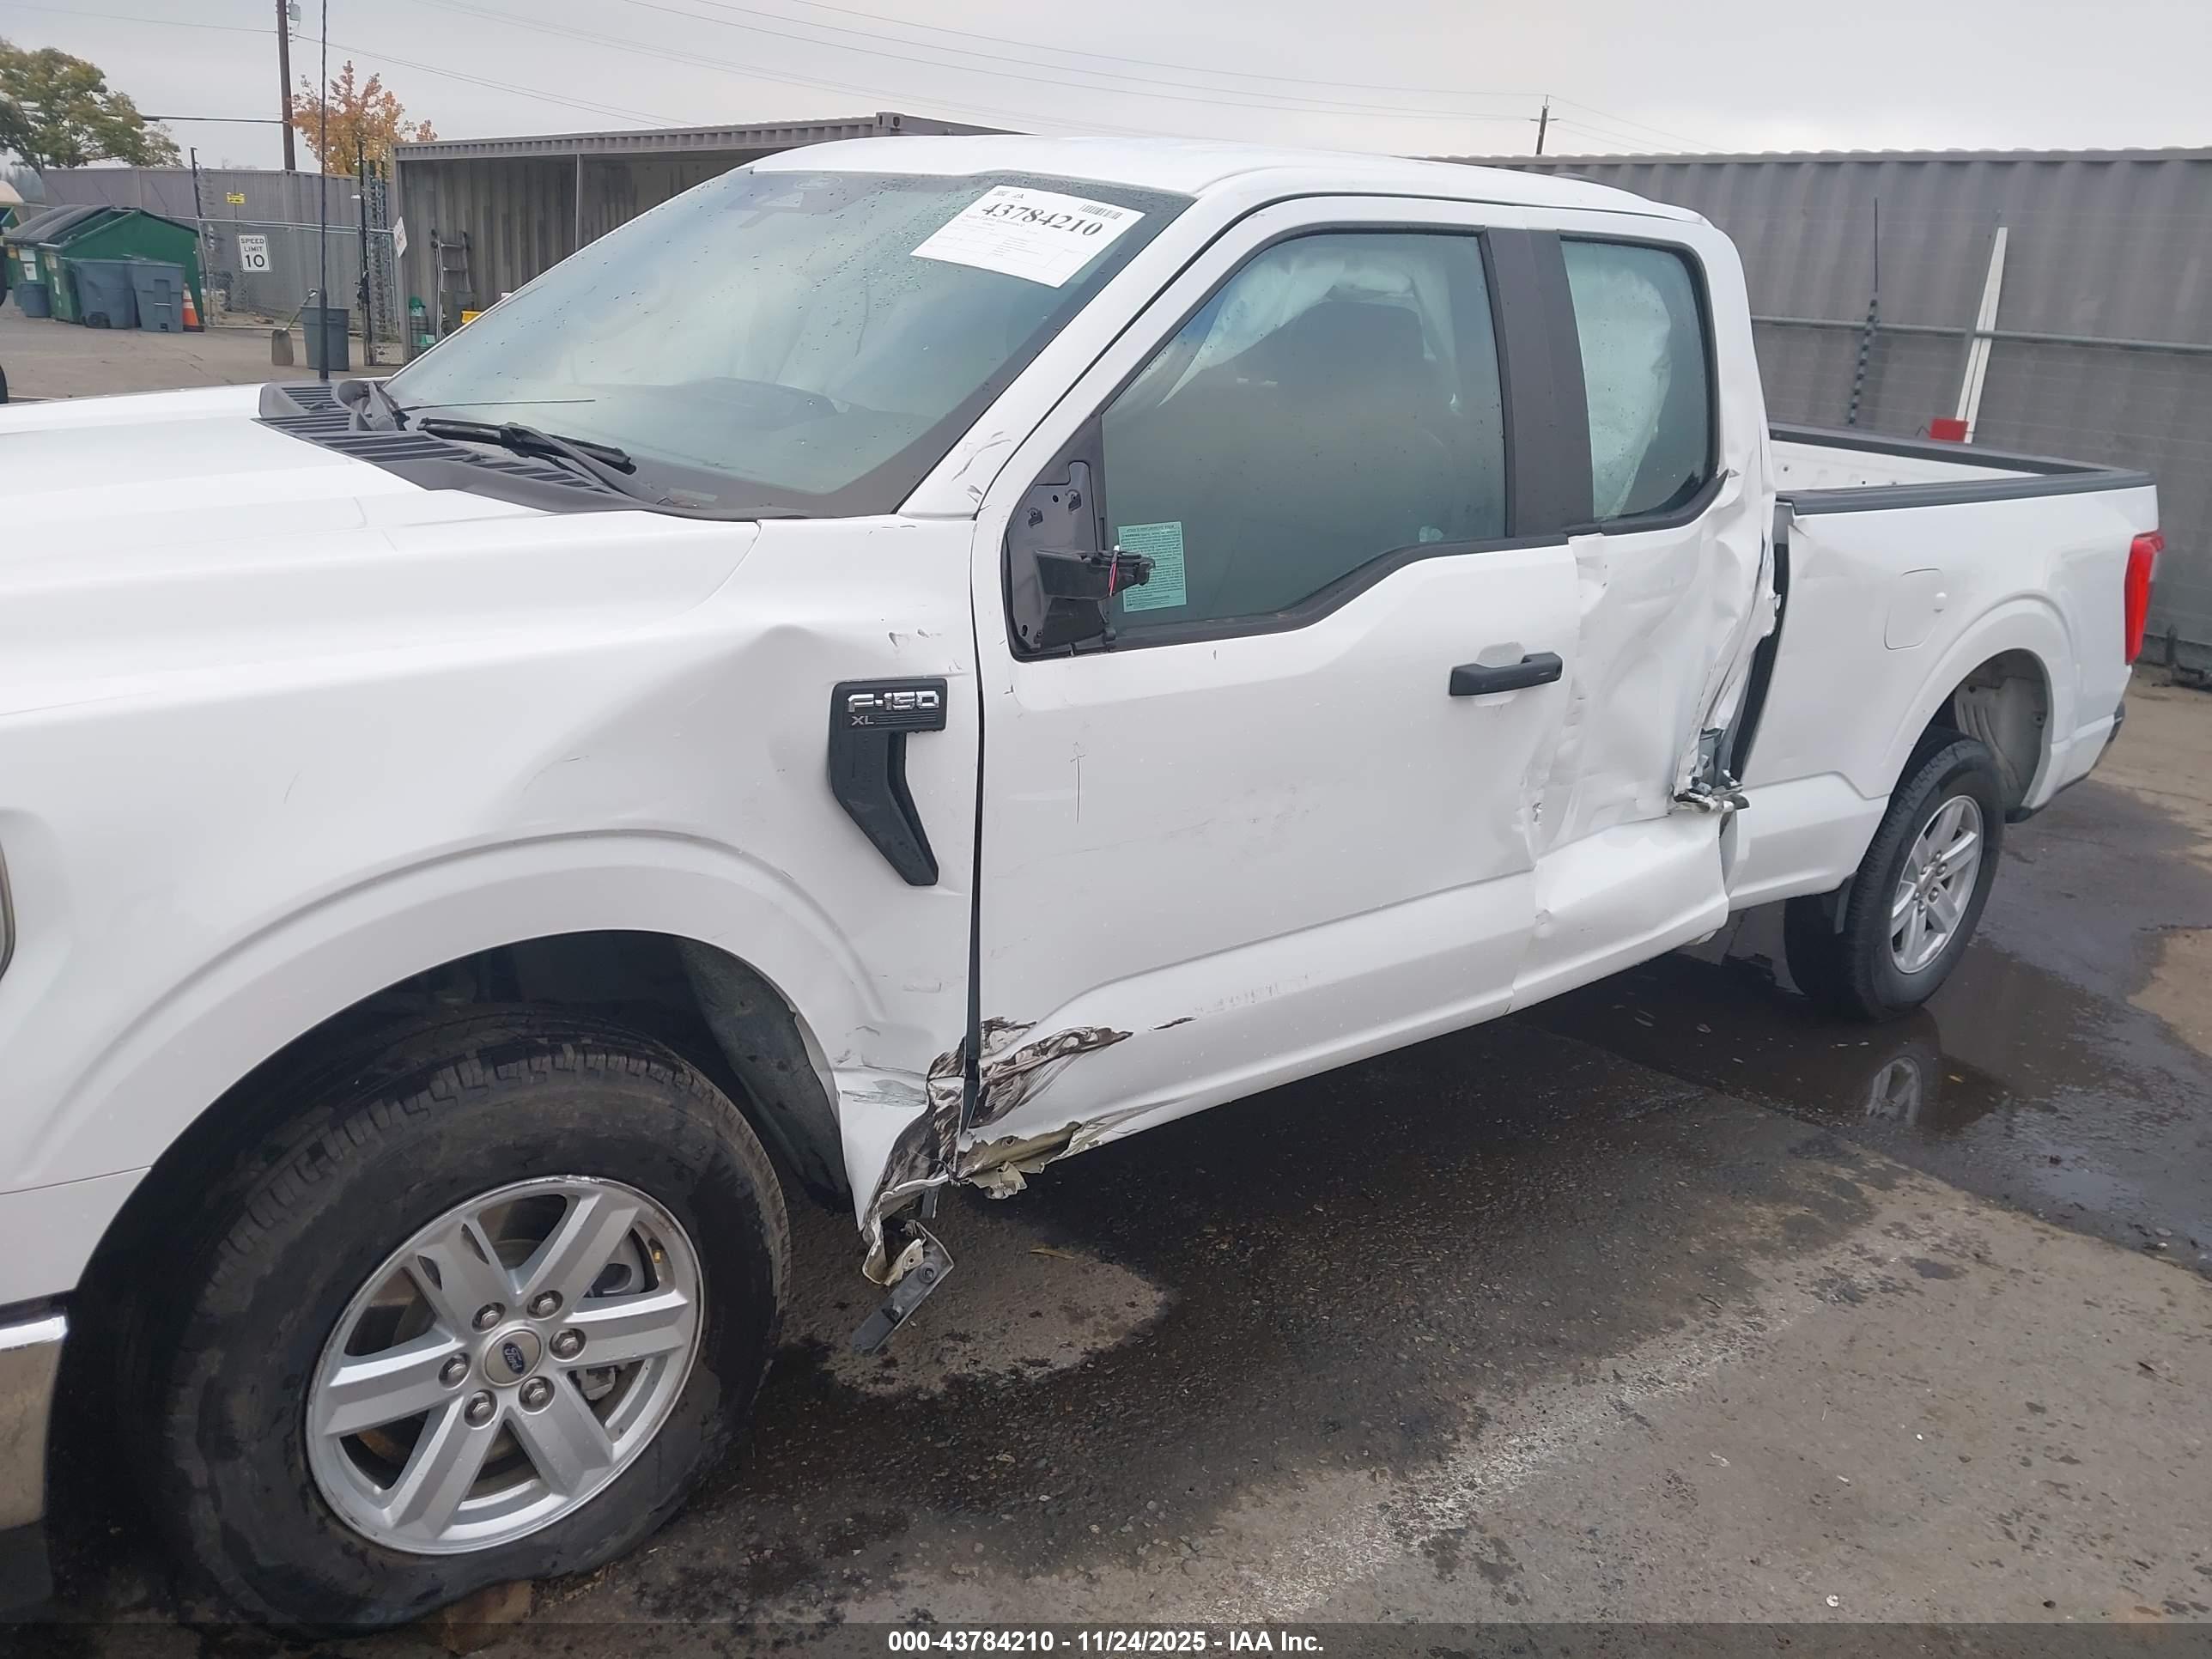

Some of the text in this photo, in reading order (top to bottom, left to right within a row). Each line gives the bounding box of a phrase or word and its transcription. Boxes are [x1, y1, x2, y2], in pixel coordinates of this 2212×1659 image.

[981, 203, 1103, 236] 43784210
[246, 254, 265, 268] 10
[848, 690, 939, 713] F-150
[851, 715, 875, 726] XL
[504, 1346, 523, 1370] Ford
